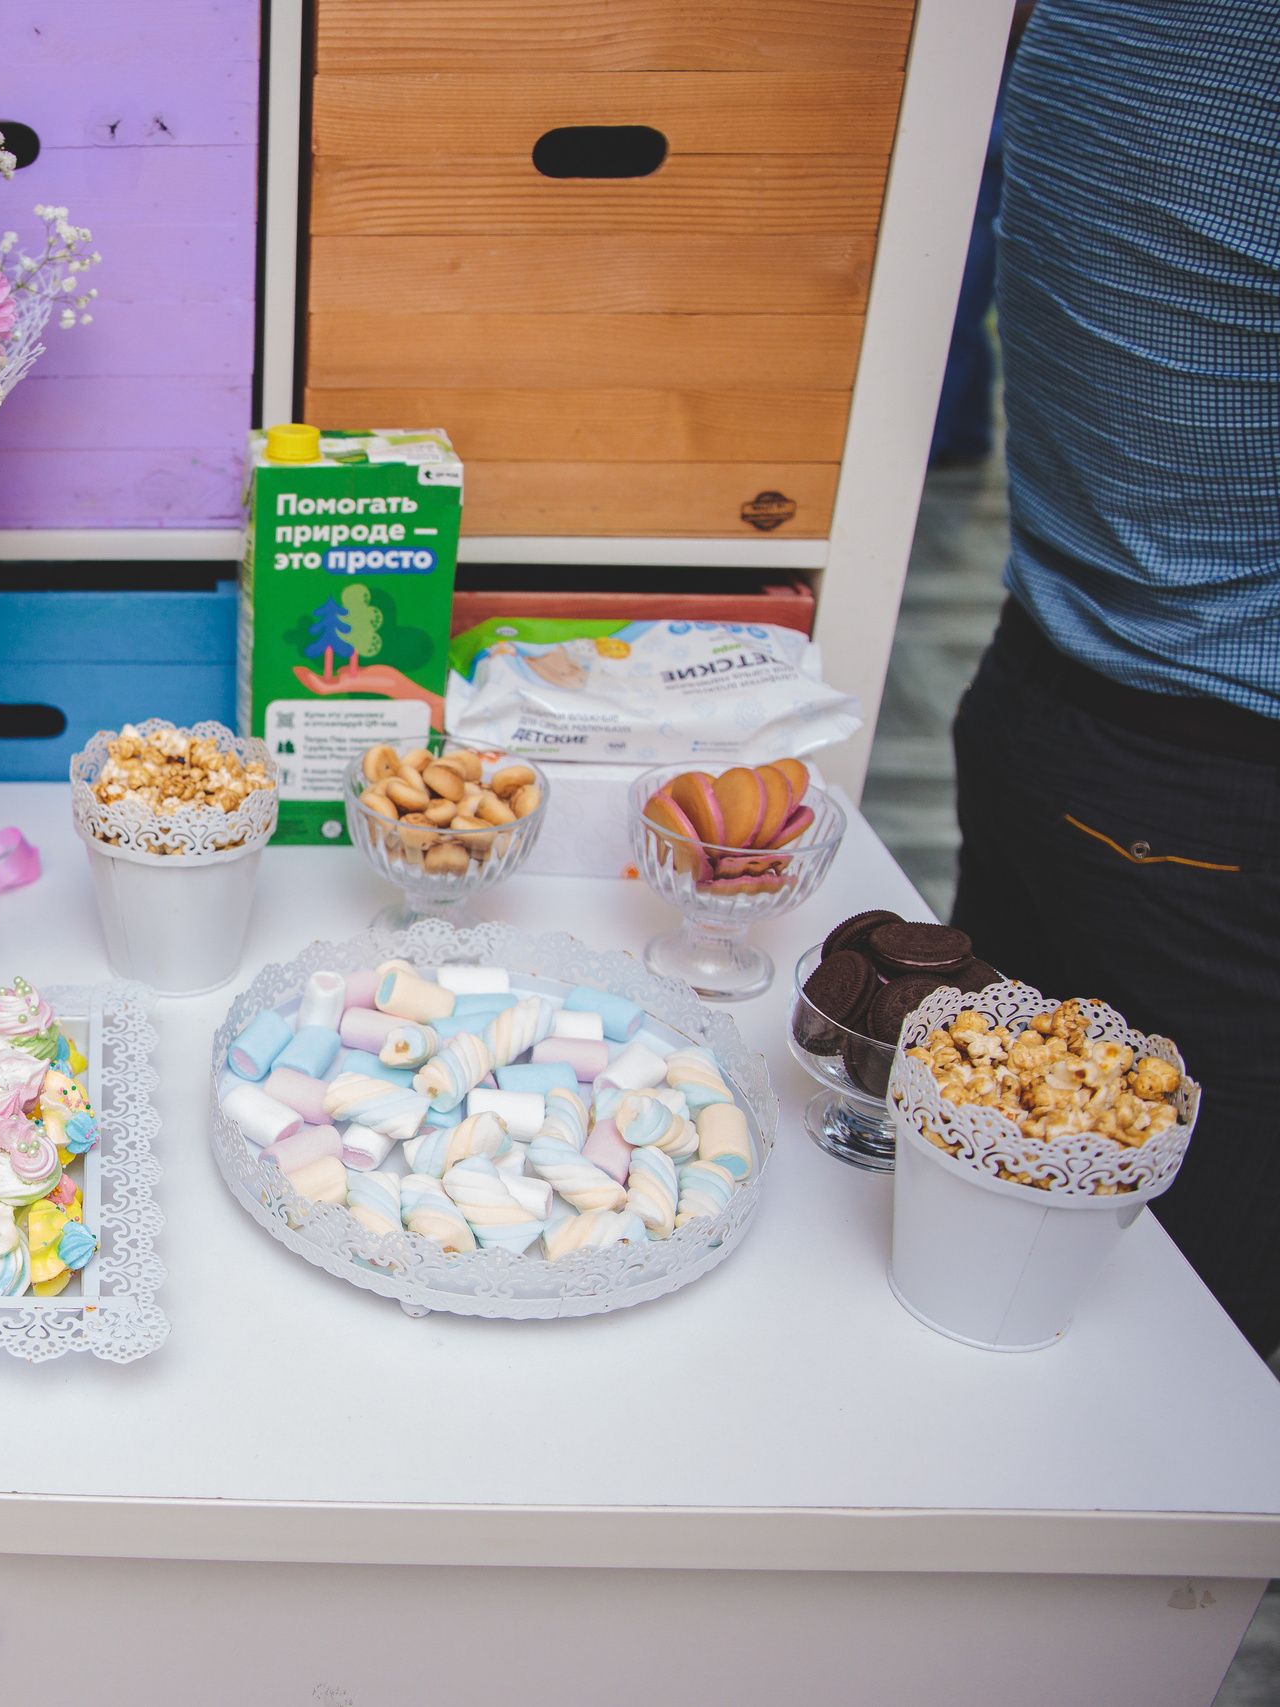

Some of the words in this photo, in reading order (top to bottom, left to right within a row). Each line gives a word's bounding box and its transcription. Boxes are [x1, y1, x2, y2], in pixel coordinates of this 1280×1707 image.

[276, 493, 419, 516] Помогать
[275, 523, 407, 548] природе
[274, 551, 323, 570] это
[327, 550, 434, 575] просто
[659, 651, 788, 683] ЕТСКИЕ
[511, 726, 589, 745] ДЕТСКИЕ
